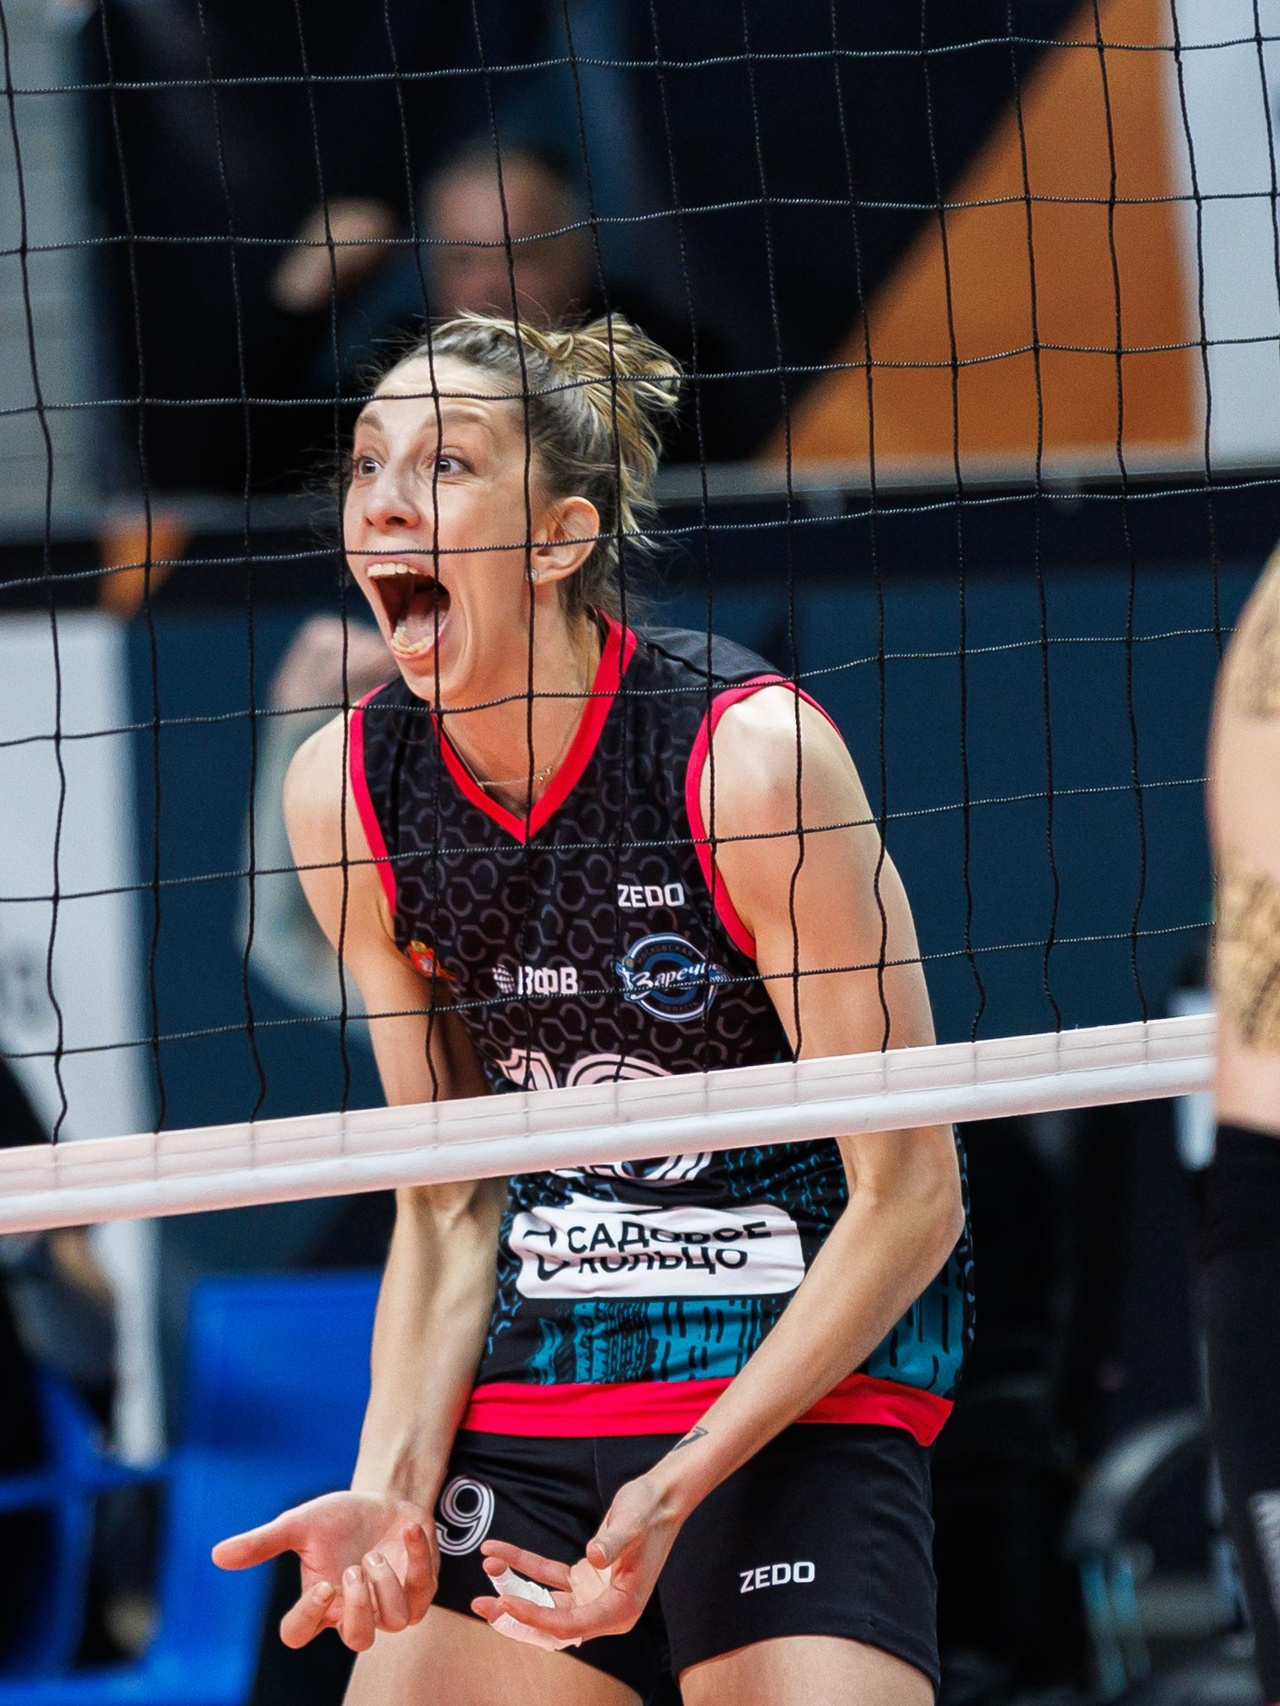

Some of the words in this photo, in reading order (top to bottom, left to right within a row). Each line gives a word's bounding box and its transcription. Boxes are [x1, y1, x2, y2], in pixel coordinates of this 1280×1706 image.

[617, 882, 685, 909] ZEDO
[435, 1475, 496, 1556] 9
[738, 1560, 816, 1594] ZEDO
